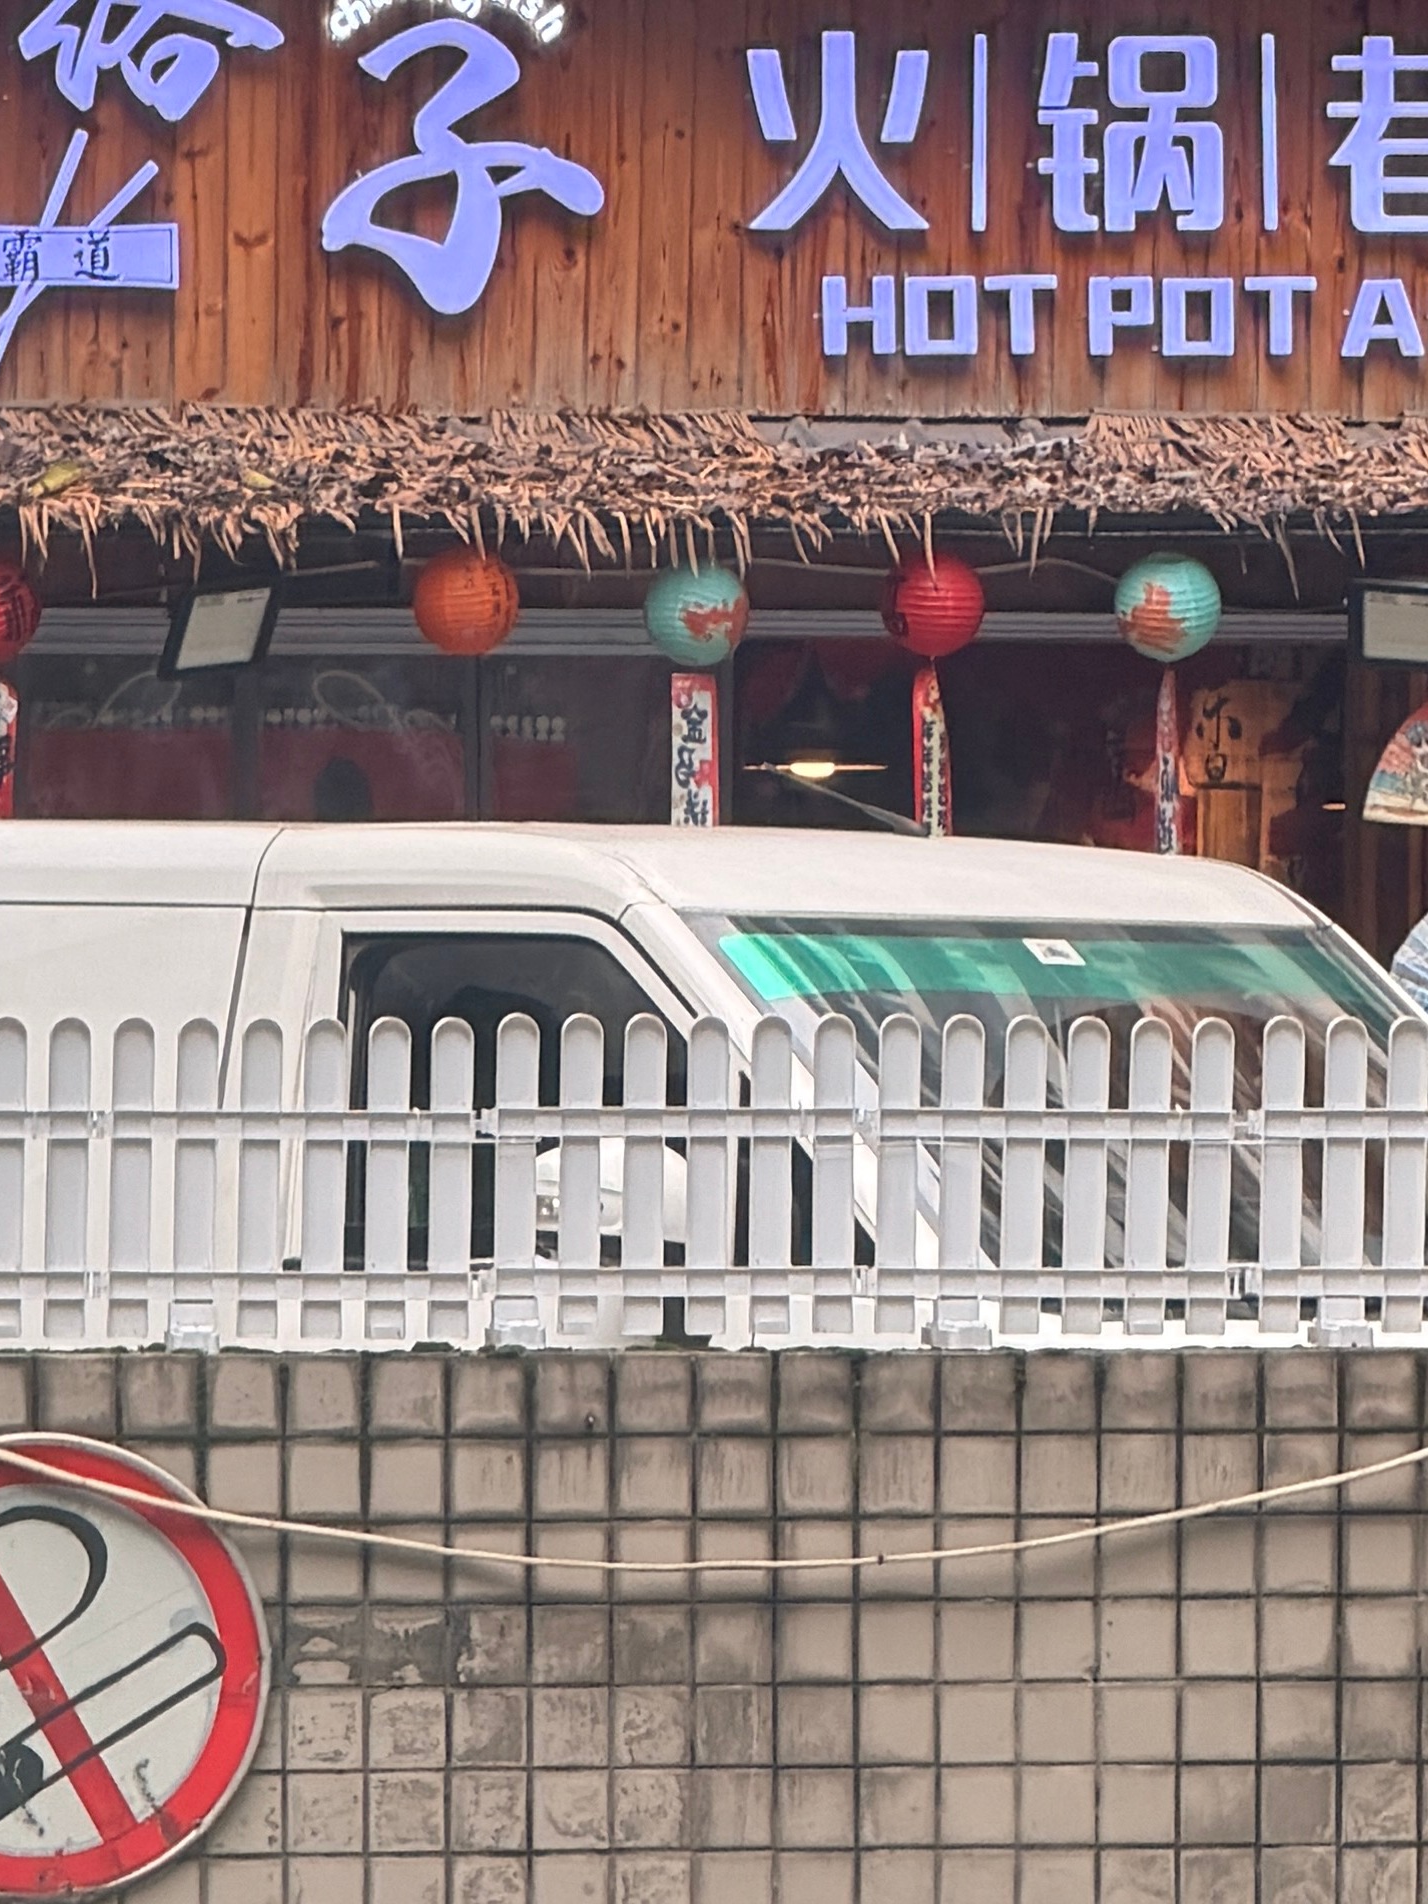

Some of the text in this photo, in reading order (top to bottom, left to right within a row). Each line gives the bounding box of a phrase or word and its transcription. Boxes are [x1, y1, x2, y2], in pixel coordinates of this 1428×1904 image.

[3, 229, 120, 294] 霸道
[821, 274, 1058, 358] HOT
[1089, 274, 1317, 359] POT
